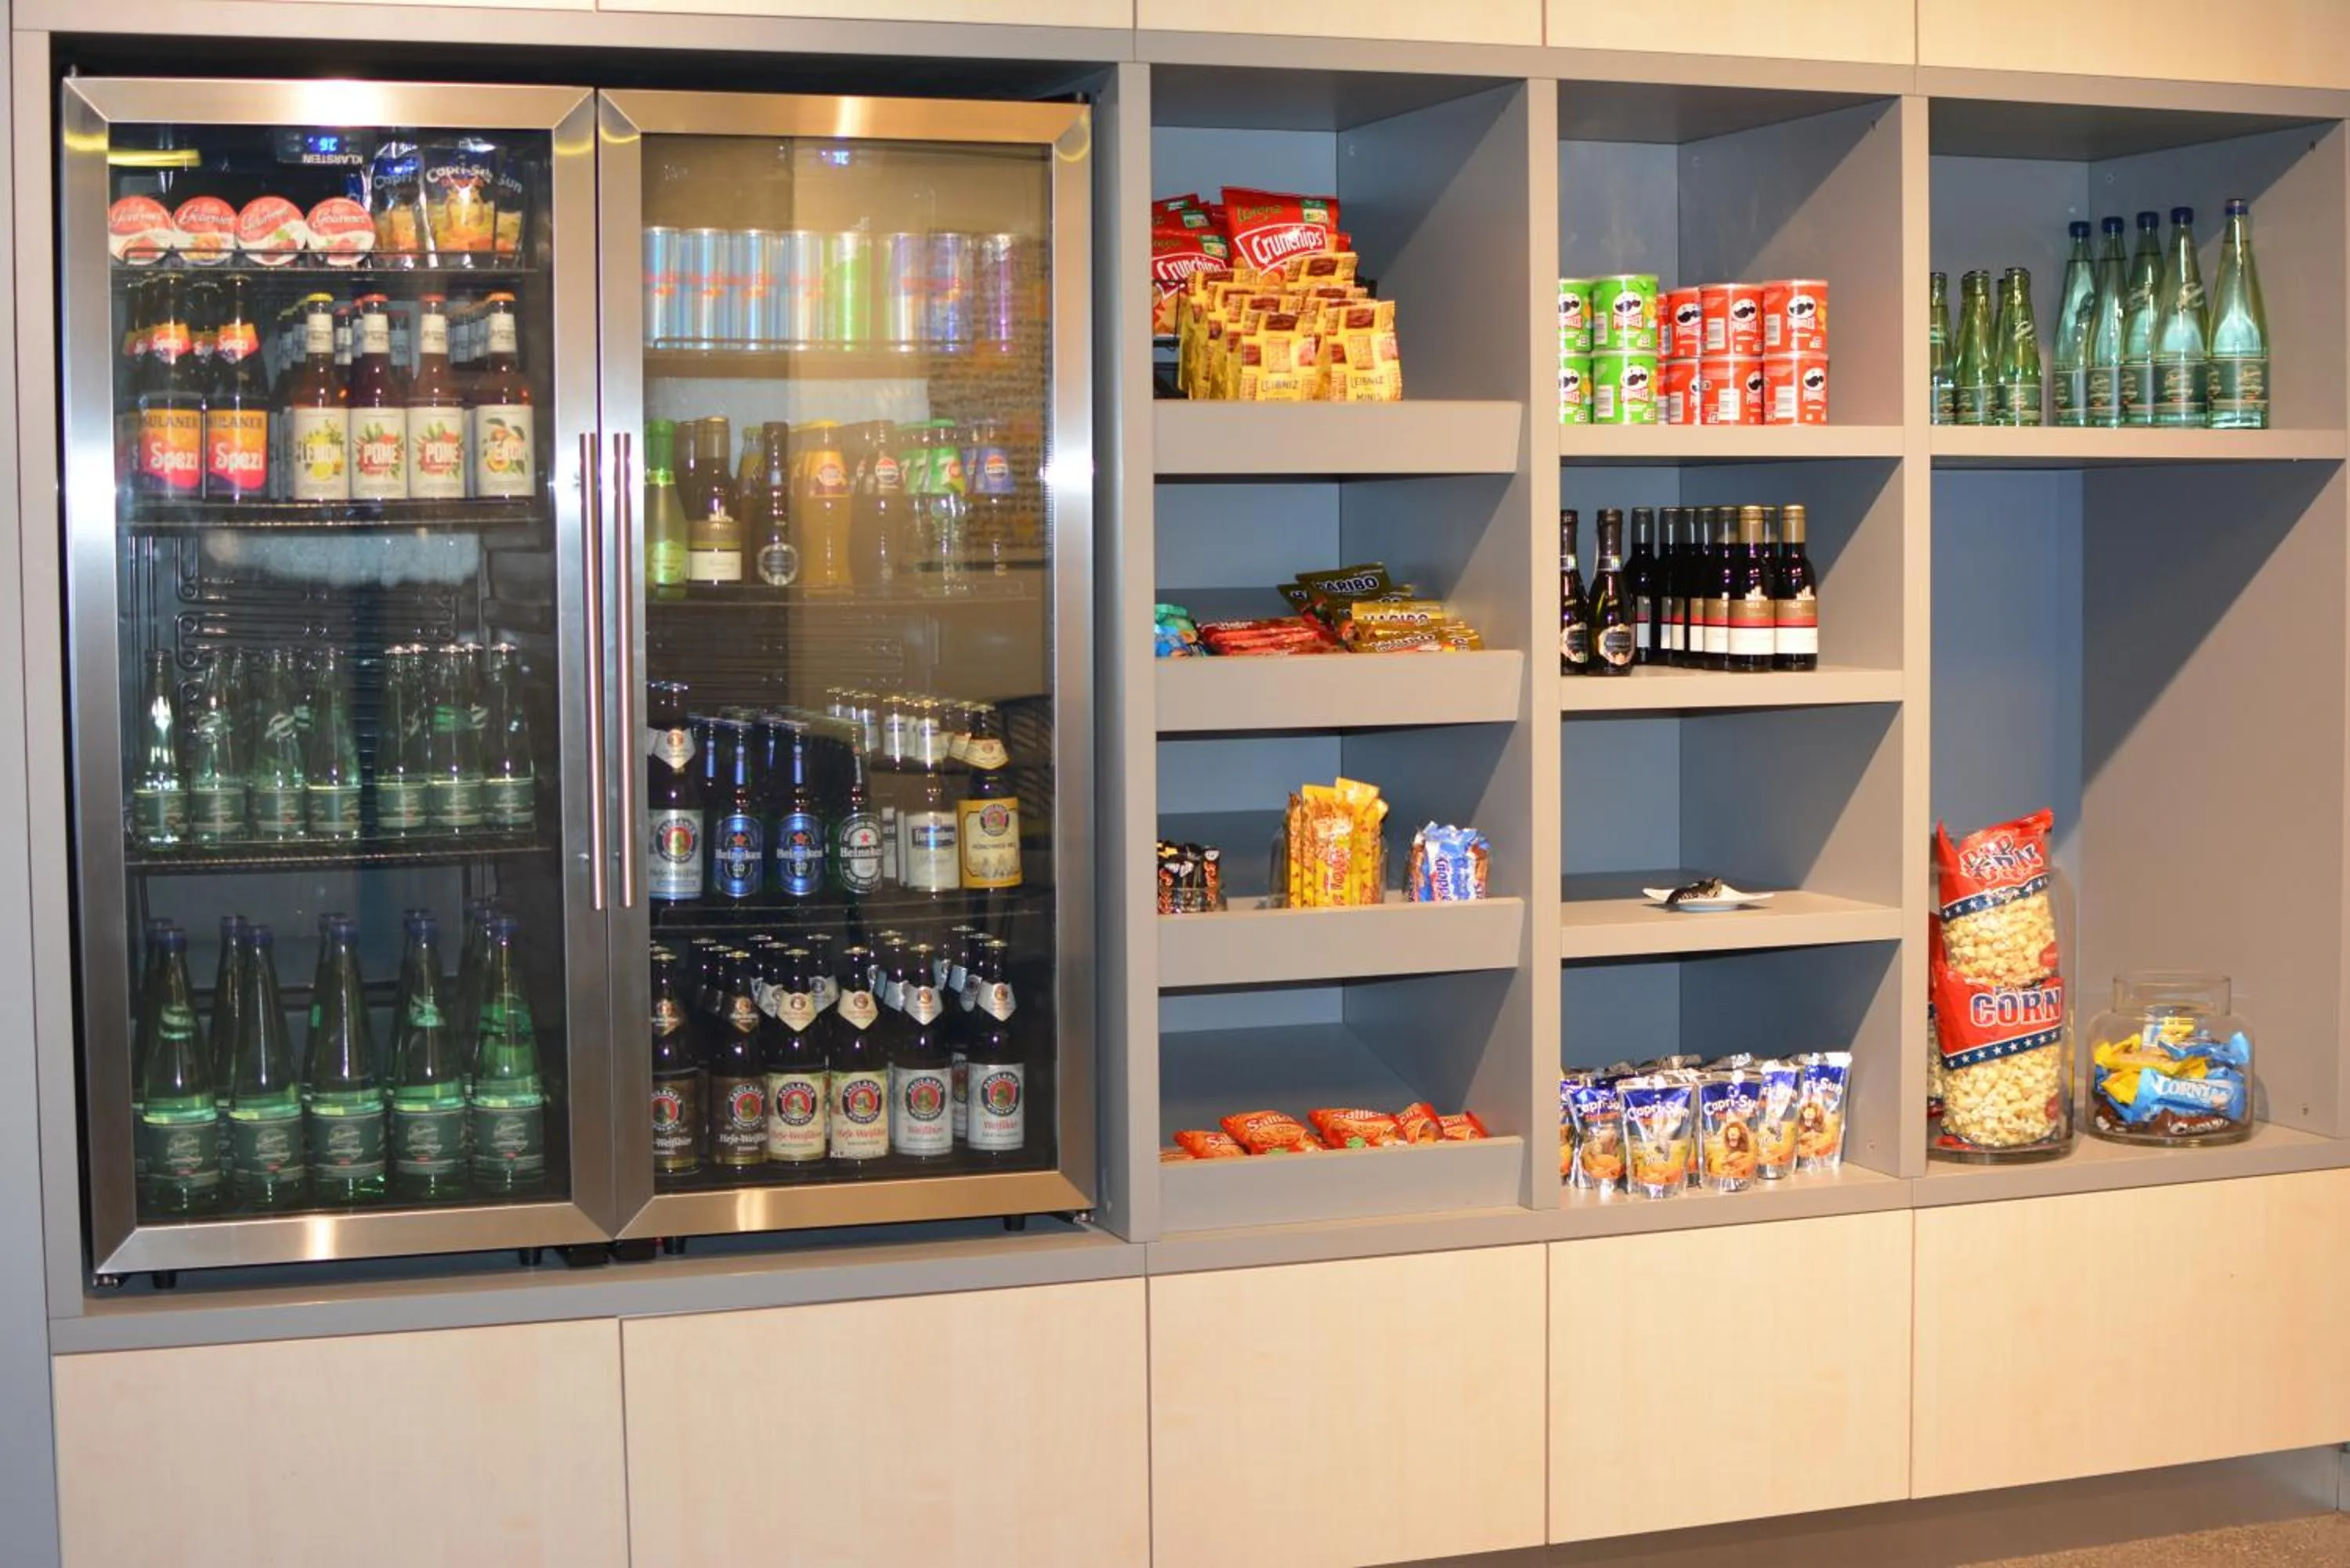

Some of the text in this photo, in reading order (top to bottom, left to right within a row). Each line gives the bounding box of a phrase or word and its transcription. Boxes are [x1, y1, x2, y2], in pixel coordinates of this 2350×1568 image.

[1251, 227, 1323, 265] Crunchips
[150, 441, 198, 473] Spezi
[215, 441, 264, 473] Spezi
[1971, 986, 2063, 1028] CORN
[1802, 1076, 1843, 1095] ri-Sun
[1575, 1097, 1622, 1118] Capri-Su
[1703, 1093, 1758, 1116] Capri-Su
